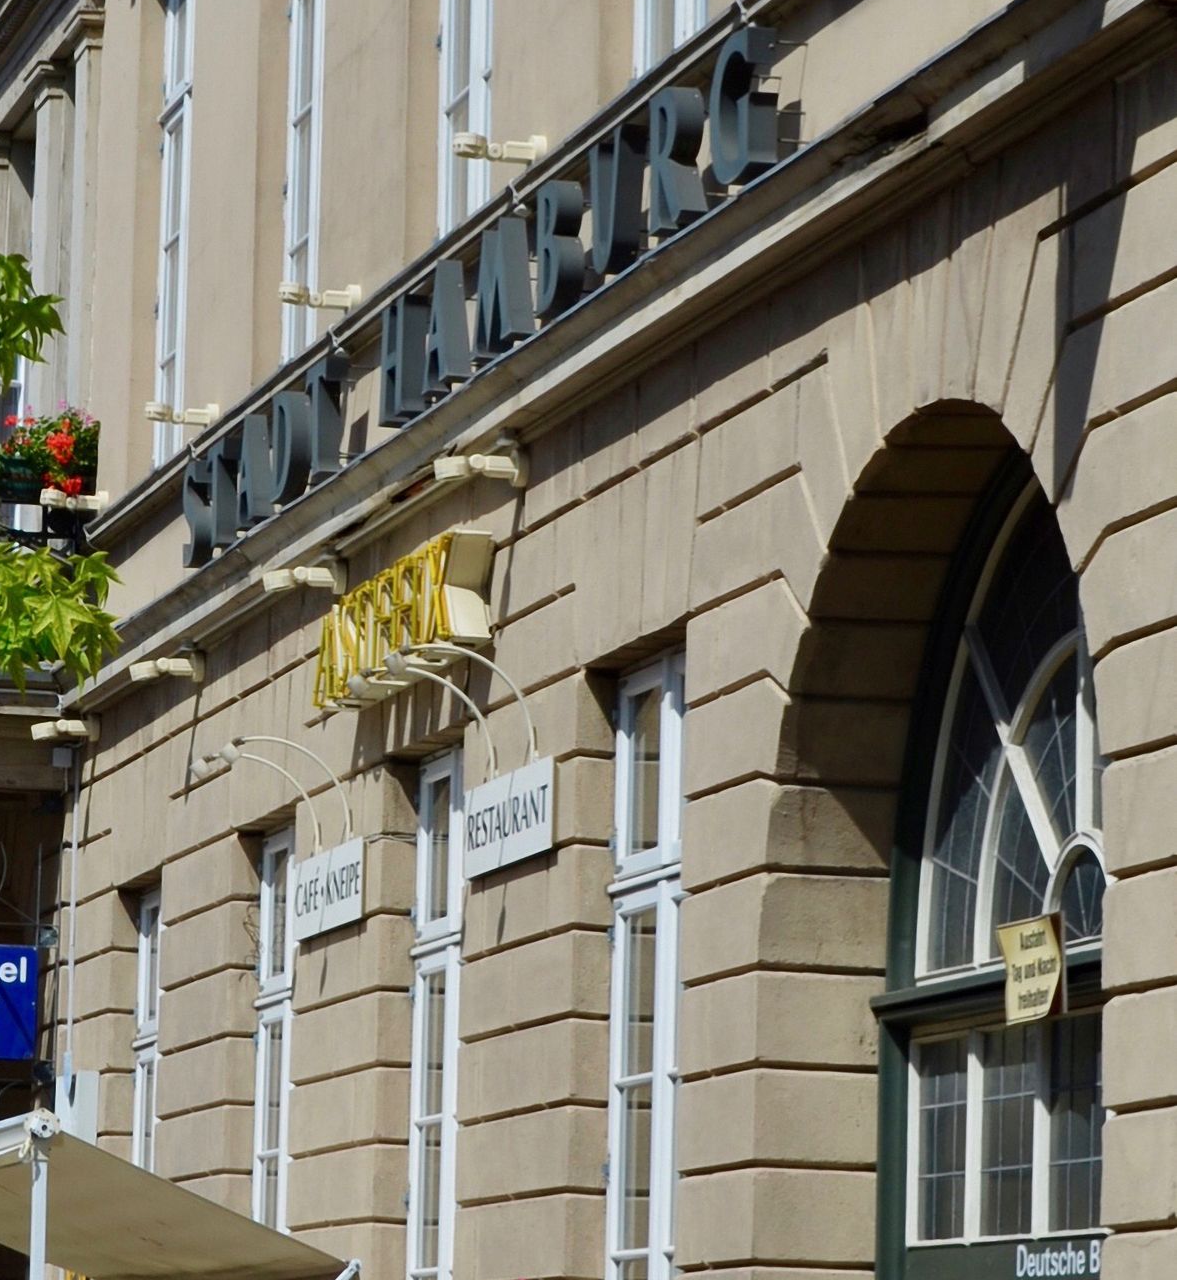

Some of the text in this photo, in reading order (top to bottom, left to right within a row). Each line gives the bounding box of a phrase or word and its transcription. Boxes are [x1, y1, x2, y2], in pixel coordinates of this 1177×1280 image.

[183, 26, 778, 569] STADT HAMBURG
[467, 784, 548, 852] RESTAURANT
[326, 861, 360, 905] KNEIPE
[1016, 1241, 1086, 1277] Deutsche
